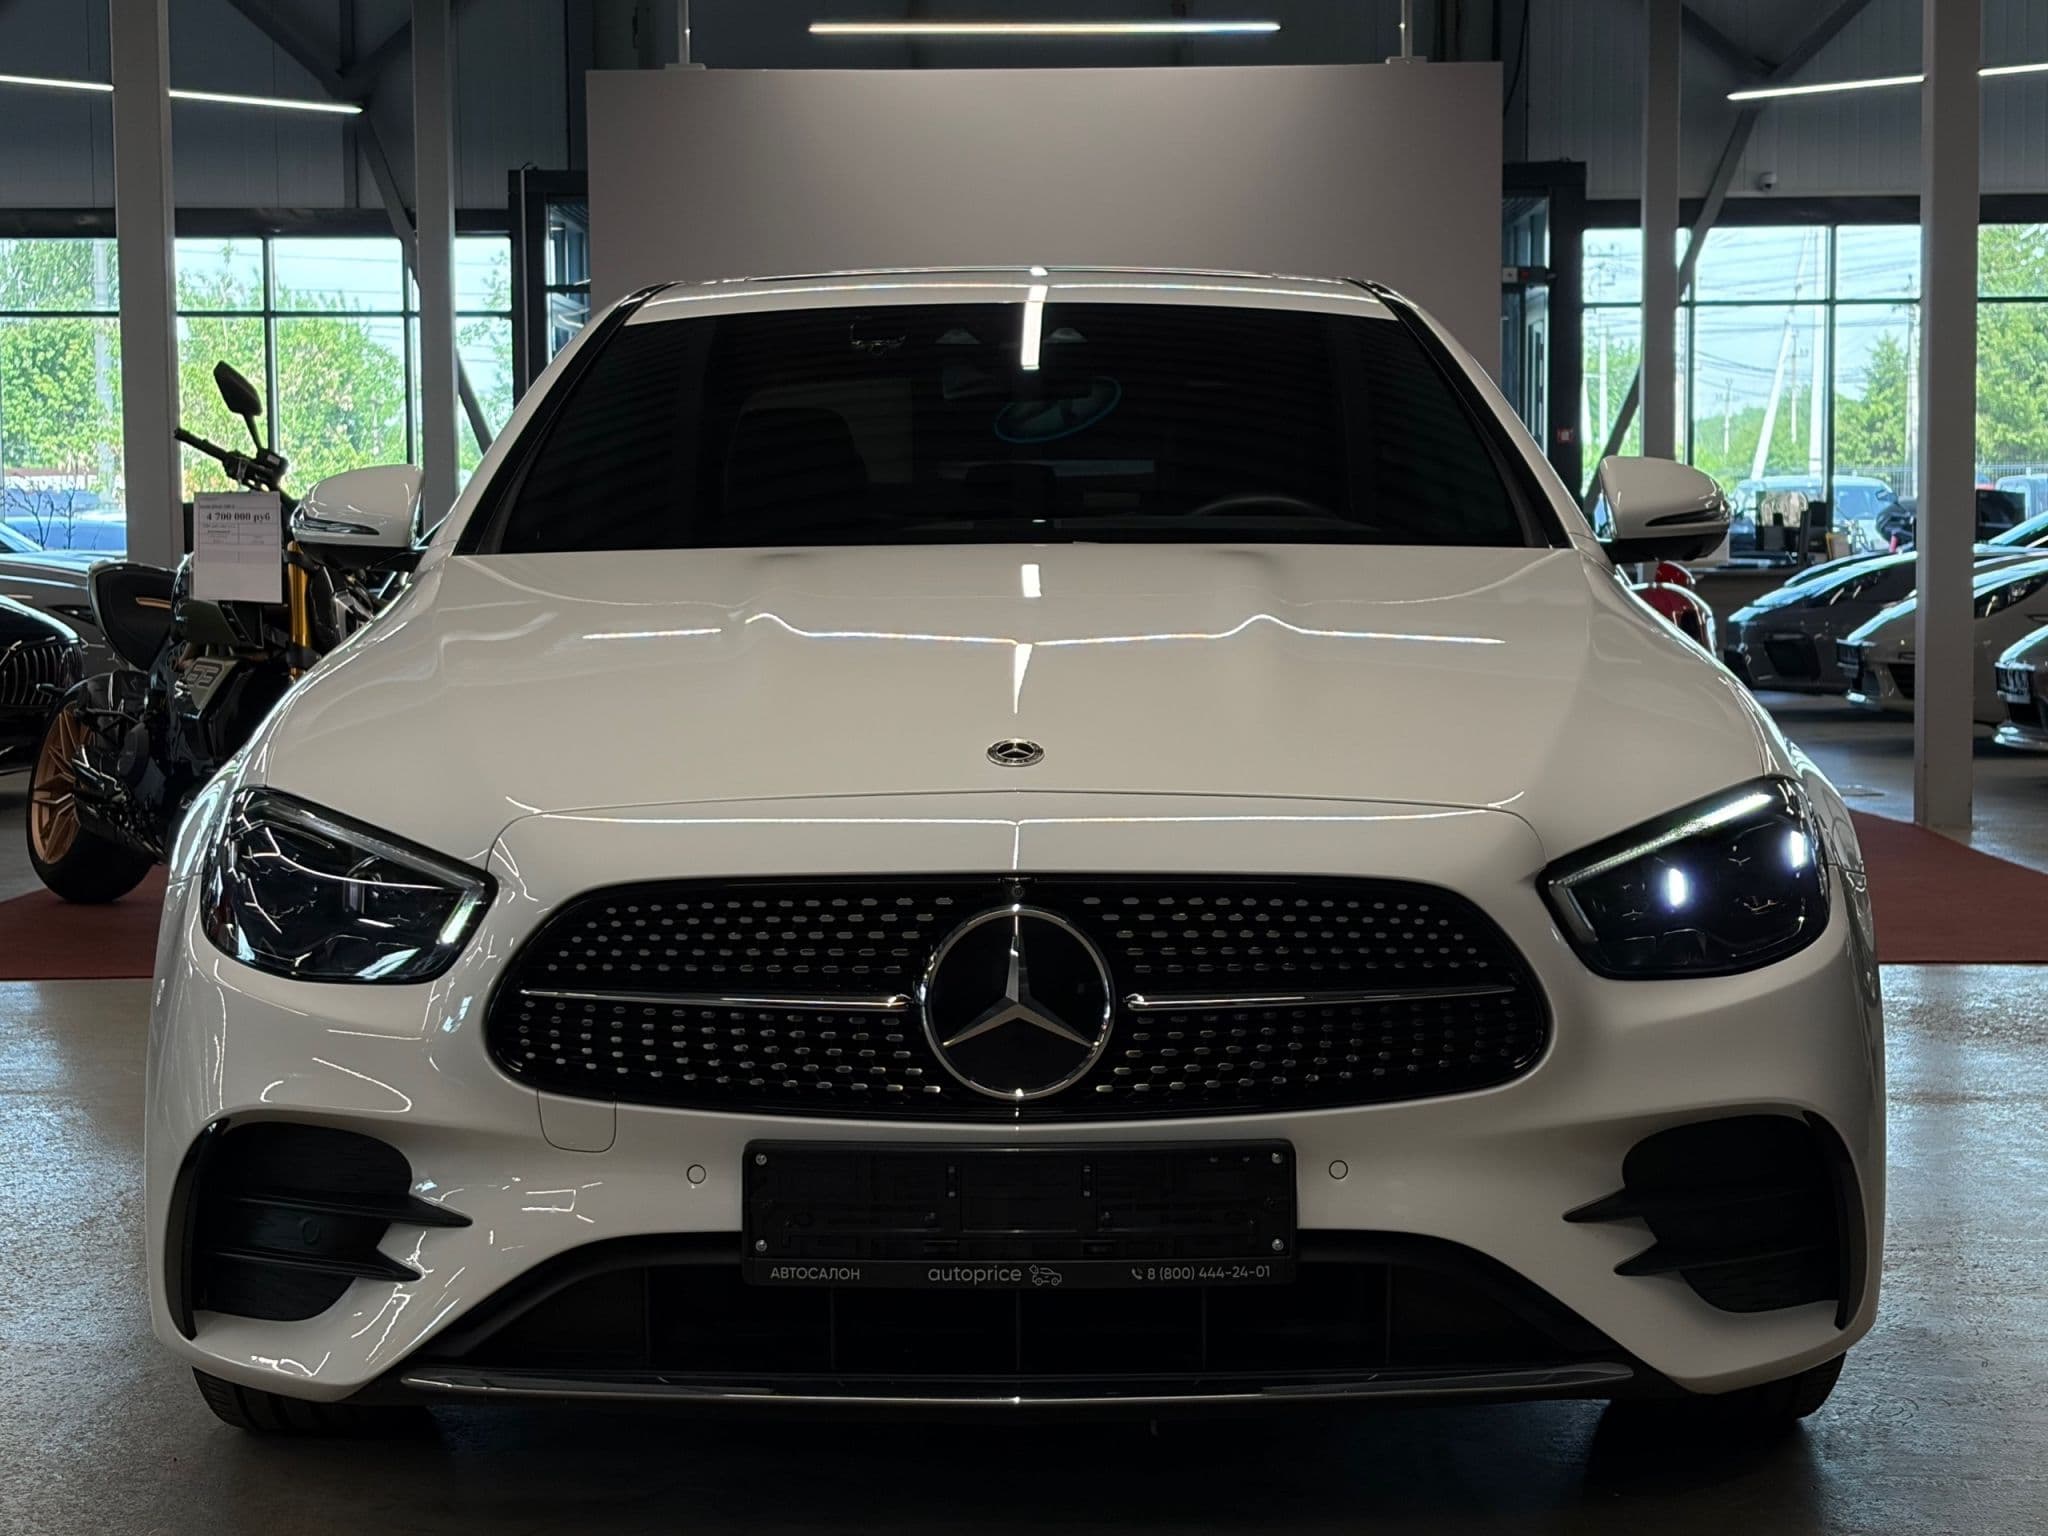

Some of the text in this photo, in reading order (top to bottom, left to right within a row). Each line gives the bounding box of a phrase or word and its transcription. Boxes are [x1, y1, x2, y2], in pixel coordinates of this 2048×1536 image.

[206, 512, 271, 523] 4 700 000 руб
[770, 1266, 861, 1281] АВТОСАЛОН
[927, 1265, 1023, 1286] autoprice
[1147, 1264, 1271, 1281] 8 (800) 444-24-01
